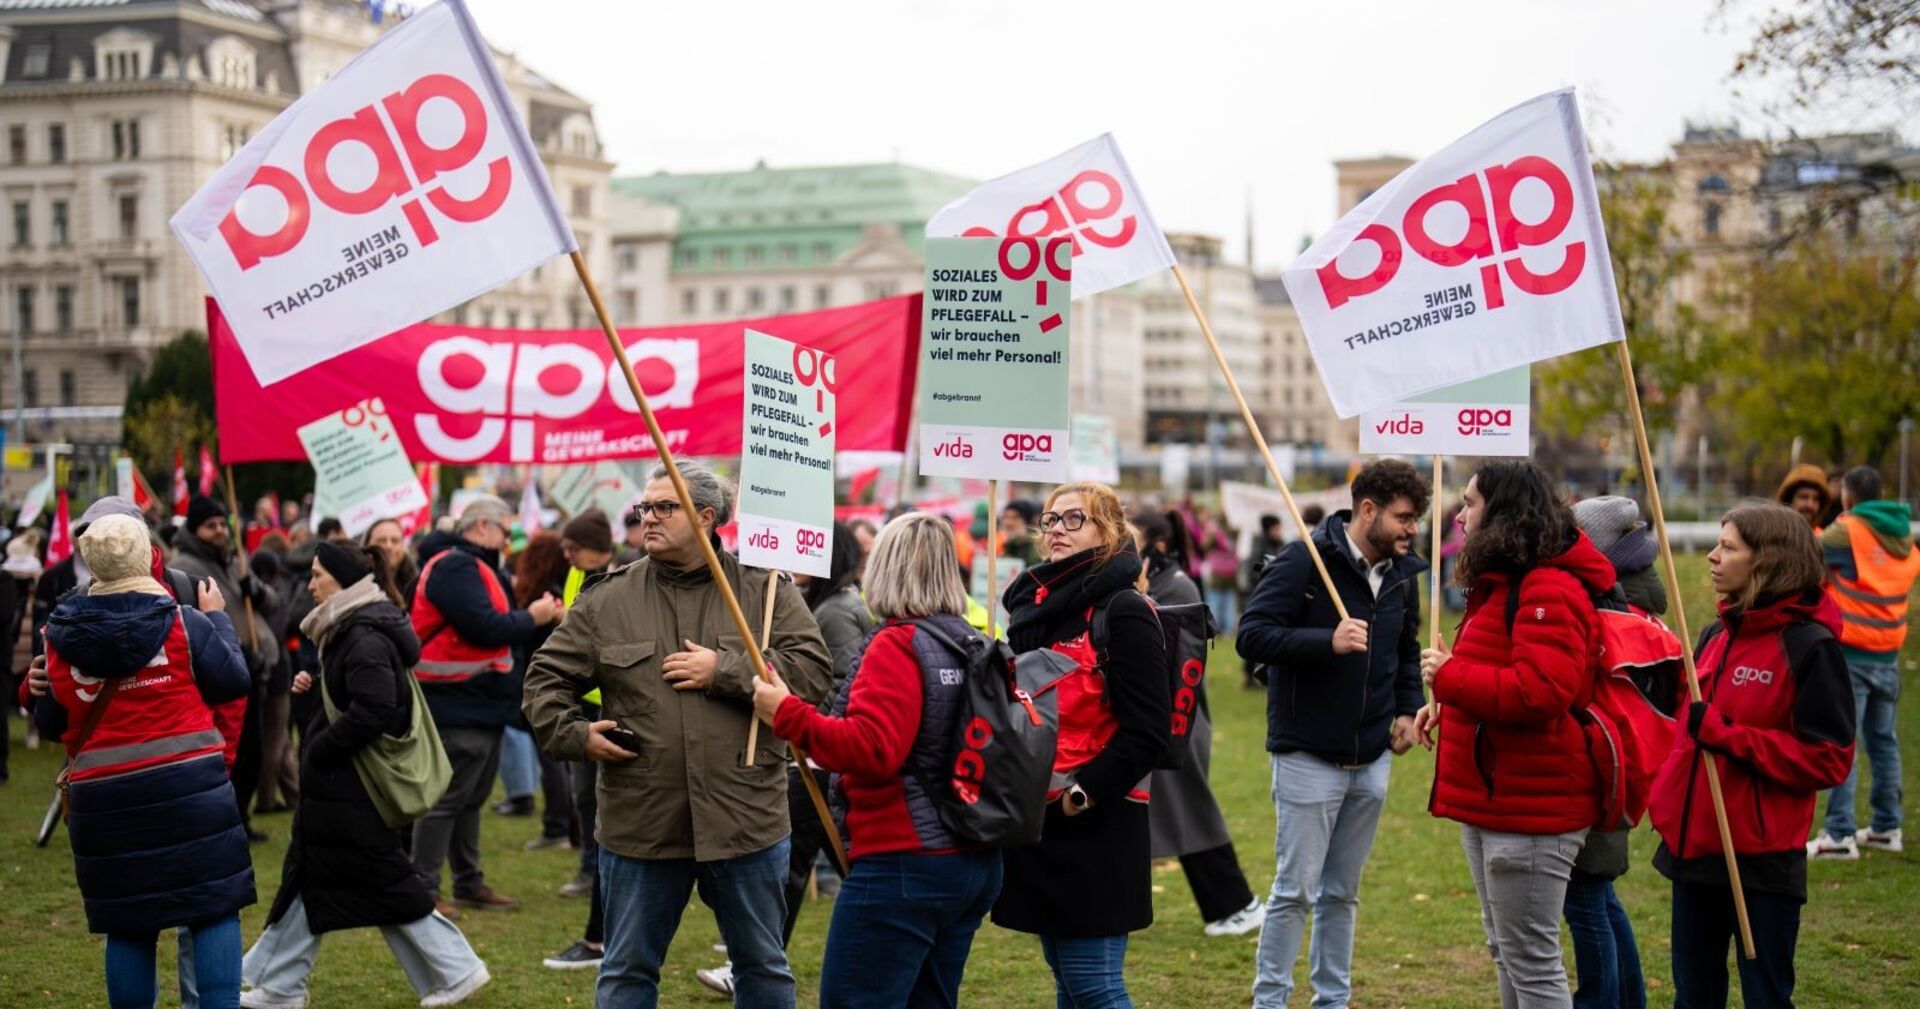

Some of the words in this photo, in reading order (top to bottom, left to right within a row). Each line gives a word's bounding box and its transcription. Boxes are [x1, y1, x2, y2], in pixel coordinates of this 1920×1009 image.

[932, 269, 998, 282] SOZIALES
[932, 289, 968, 301] WIRD
[972, 290, 1002, 302] ZUM
[931, 308, 1016, 322] PFLEGEFALL
[930, 328, 951, 340] wir
[955, 329, 1020, 342] brauchen
[930, 347, 953, 360] viel
[957, 349, 991, 361] mehr
[995, 350, 1061, 363] Personal!
[751, 363, 794, 385] SOZIALES
[414, 336, 699, 462] gpa
[751, 383, 776, 400] WIRD
[778, 389, 798, 406] ZUM
[933, 392, 981, 402] #abgebrannt
[751, 403, 806, 428] PFLEGEFALL
[1376, 414, 1423, 435] vida
[1457, 409, 1512, 436] gpa
[544, 429, 604, 447] MEINE
[750, 424, 766, 436] wir
[768, 426, 809, 446] brauchen
[750, 442, 767, 457] viel
[769, 448, 793, 461] mehr
[795, 451, 831, 471] Personal!
[933, 436, 973, 459] vida
[1002, 433, 1052, 462] gpa
[751, 484, 786, 497] #abgebrannt
[748, 528, 779, 550] vida
[796, 528, 825, 555] gpa
[1732, 665, 1774, 688] gpa
